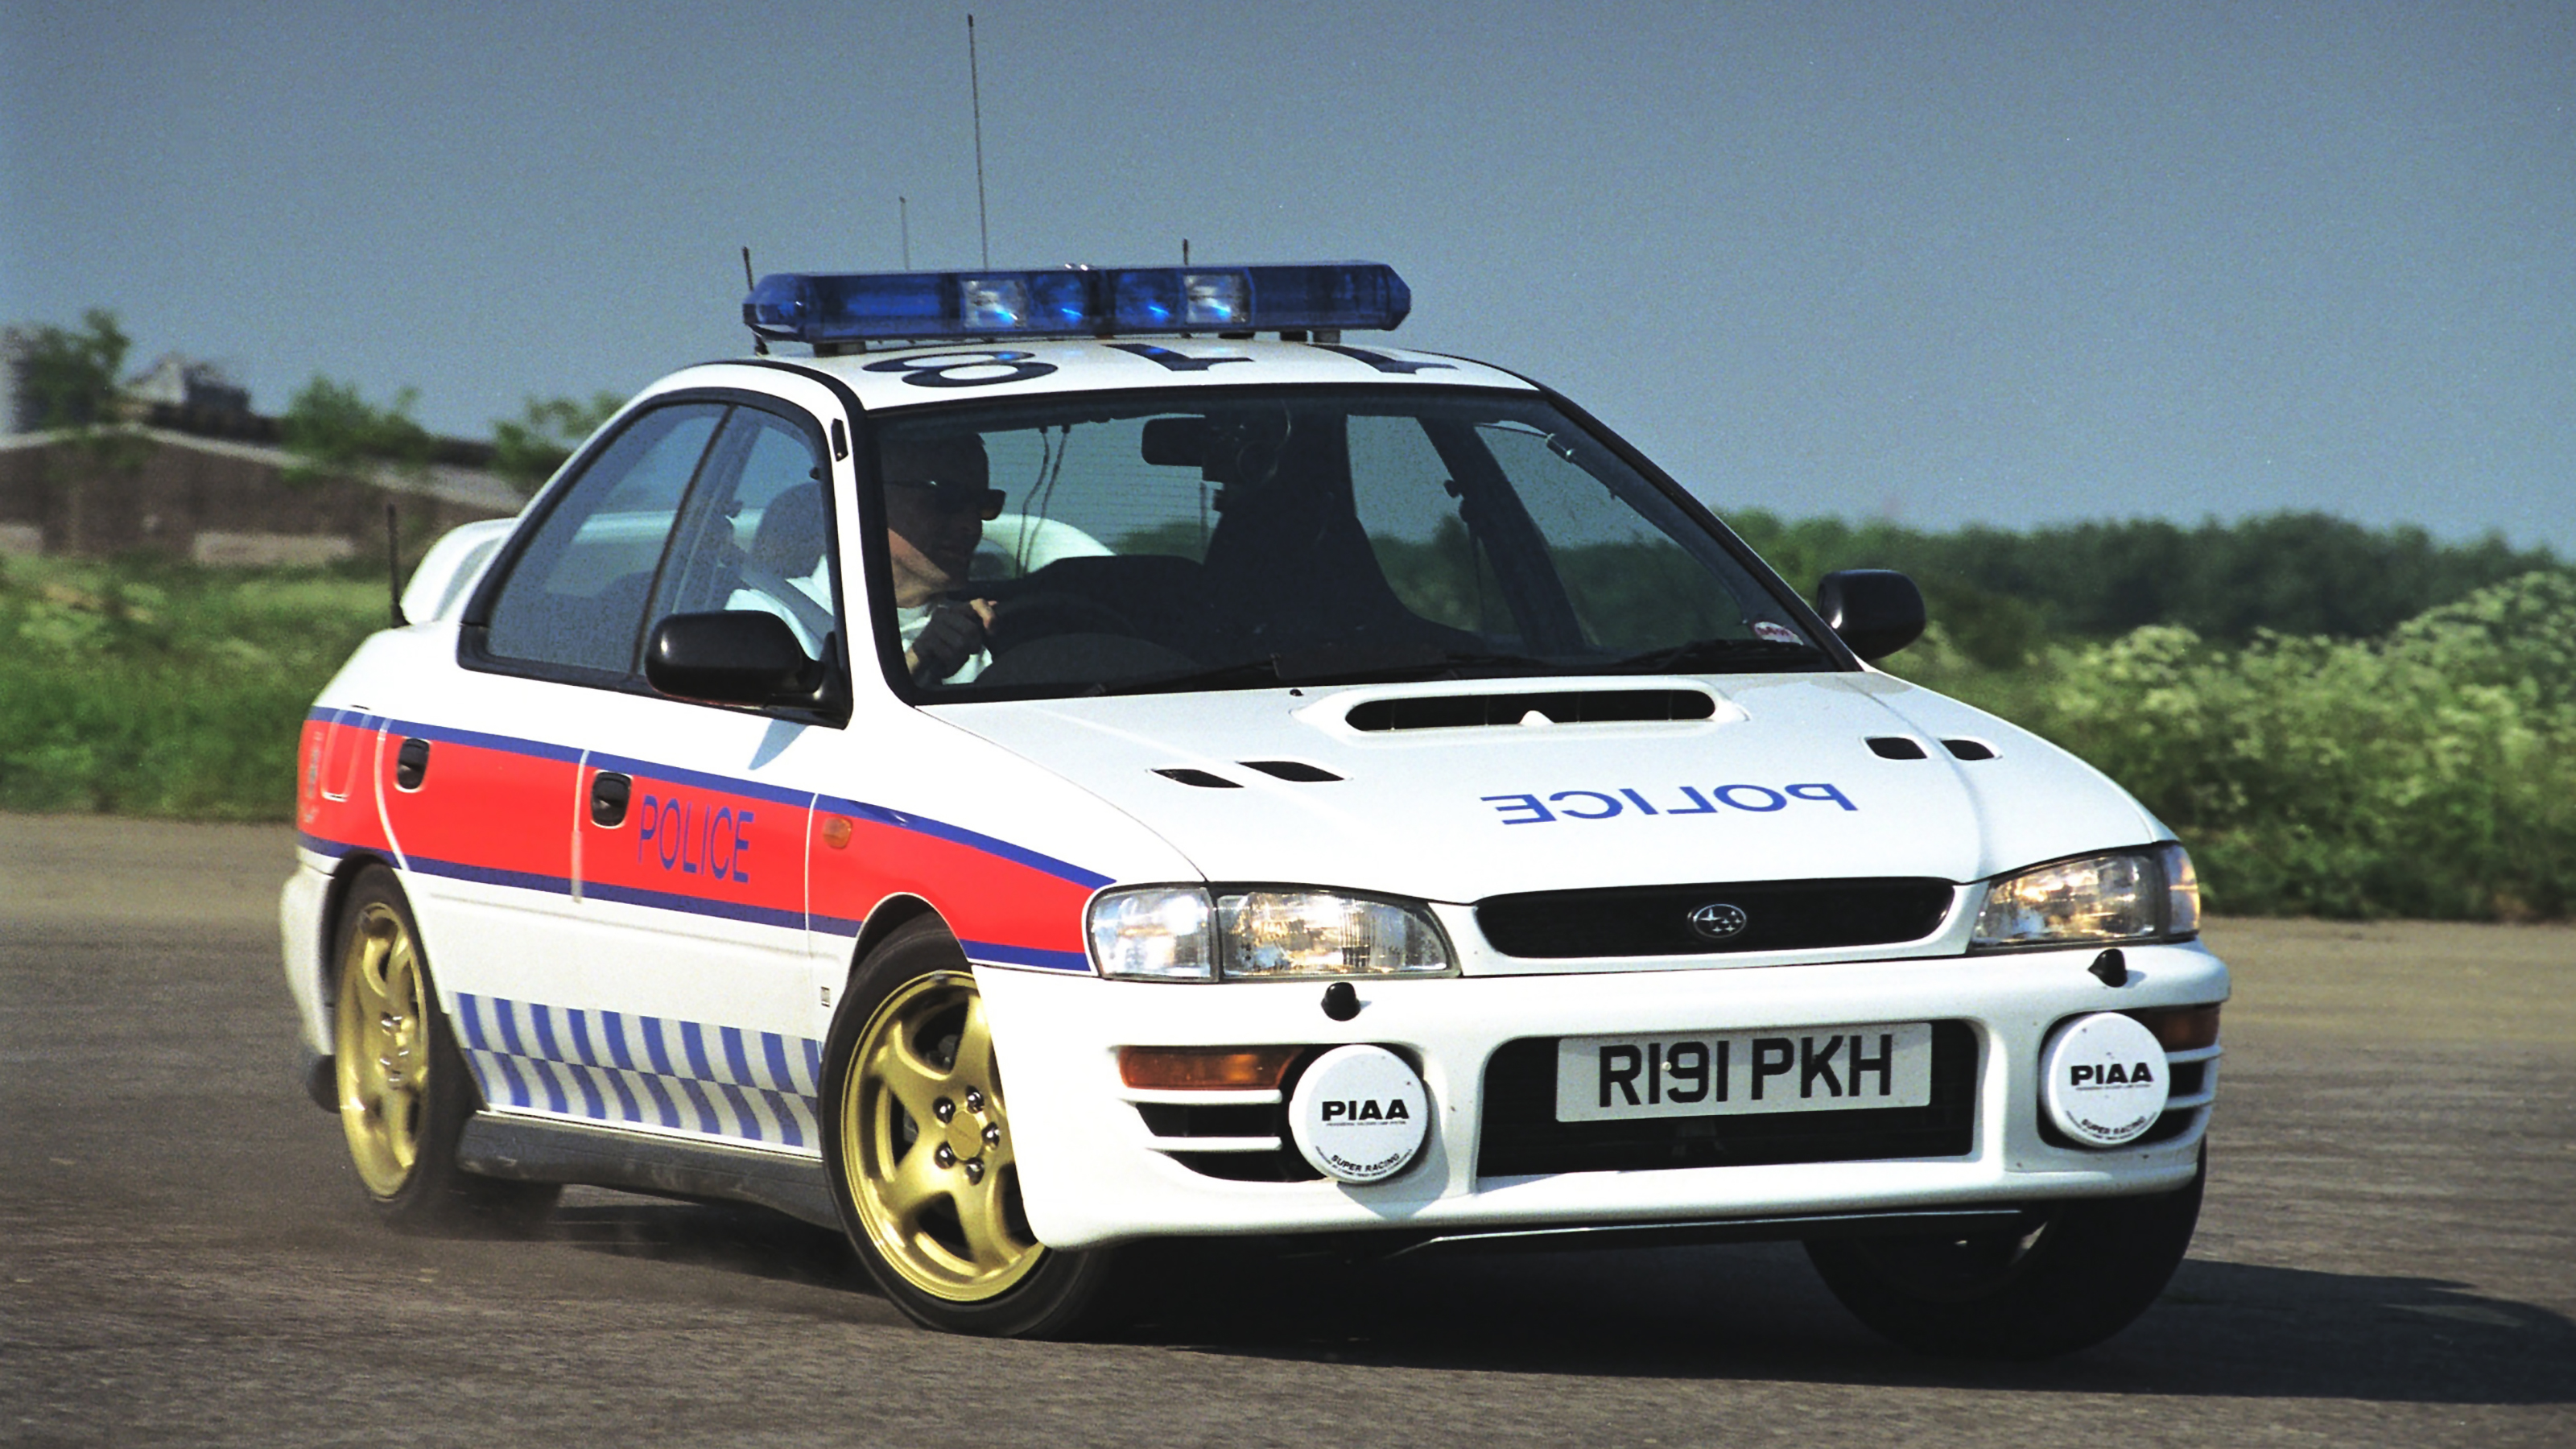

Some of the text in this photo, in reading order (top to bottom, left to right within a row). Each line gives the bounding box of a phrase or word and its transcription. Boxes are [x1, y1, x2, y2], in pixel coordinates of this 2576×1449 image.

[638, 794, 755, 884] POLICE
[1599, 1034, 1893, 1107] R191 PKH
[2070, 1062, 2154, 1085] PIAA
[1322, 1099, 1410, 1121] PIAA
[1331, 1154, 1362, 1172] SUPER
[1364, 1153, 1400, 1172] RACING
